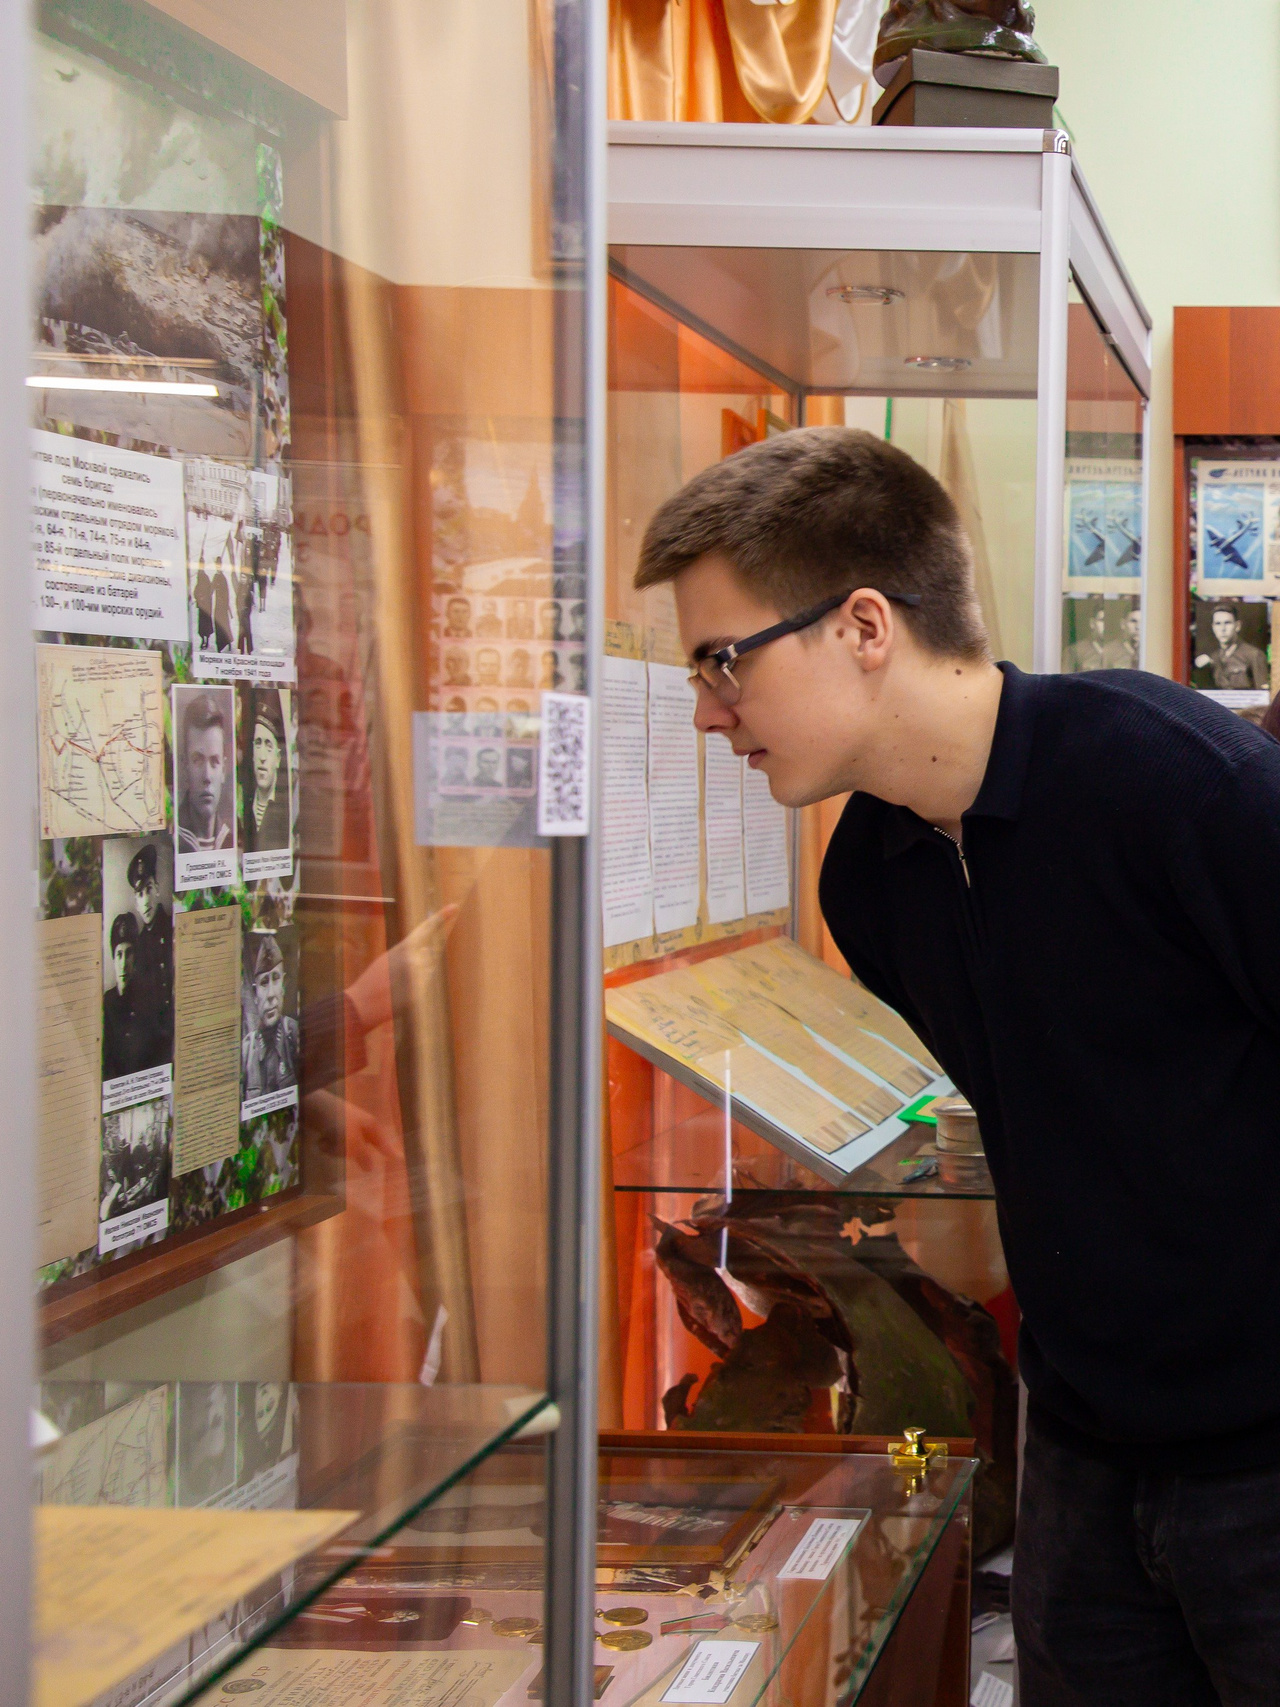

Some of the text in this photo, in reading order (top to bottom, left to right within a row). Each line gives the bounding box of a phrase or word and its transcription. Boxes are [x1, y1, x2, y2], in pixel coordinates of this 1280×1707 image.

[54, 456, 71, 468] под
[72, 456, 107, 474] Москвой
[108, 466, 151, 483] сражались
[61, 475, 115, 493] семь бригад:
[107, 501, 158, 518] именовалась
[61, 510, 108, 526] отдельным
[109, 518, 142, 533] отрядом
[127, 538, 133, 547] и
[64, 546, 110, 561] отдельный
[111, 553, 129, 564] полк
[127, 573, 172, 588] дивизионы,
[45, 580, 139, 600] состоявшие из батарей
[63, 600, 70, 610] и
[101, 604, 134, 617] морских
[135, 607, 164, 620] орудий.
[199, 655, 223, 665] Моряки
[233, 656, 258, 667] Красной
[259, 660, 286, 668] площади
[215, 666, 272, 678] 7 ноября 1941 года
[179, 869, 231, 883] Лейтенант 71 ОМСБ
[275, 1667, 328, 1705] ЕНИНГРАДА
